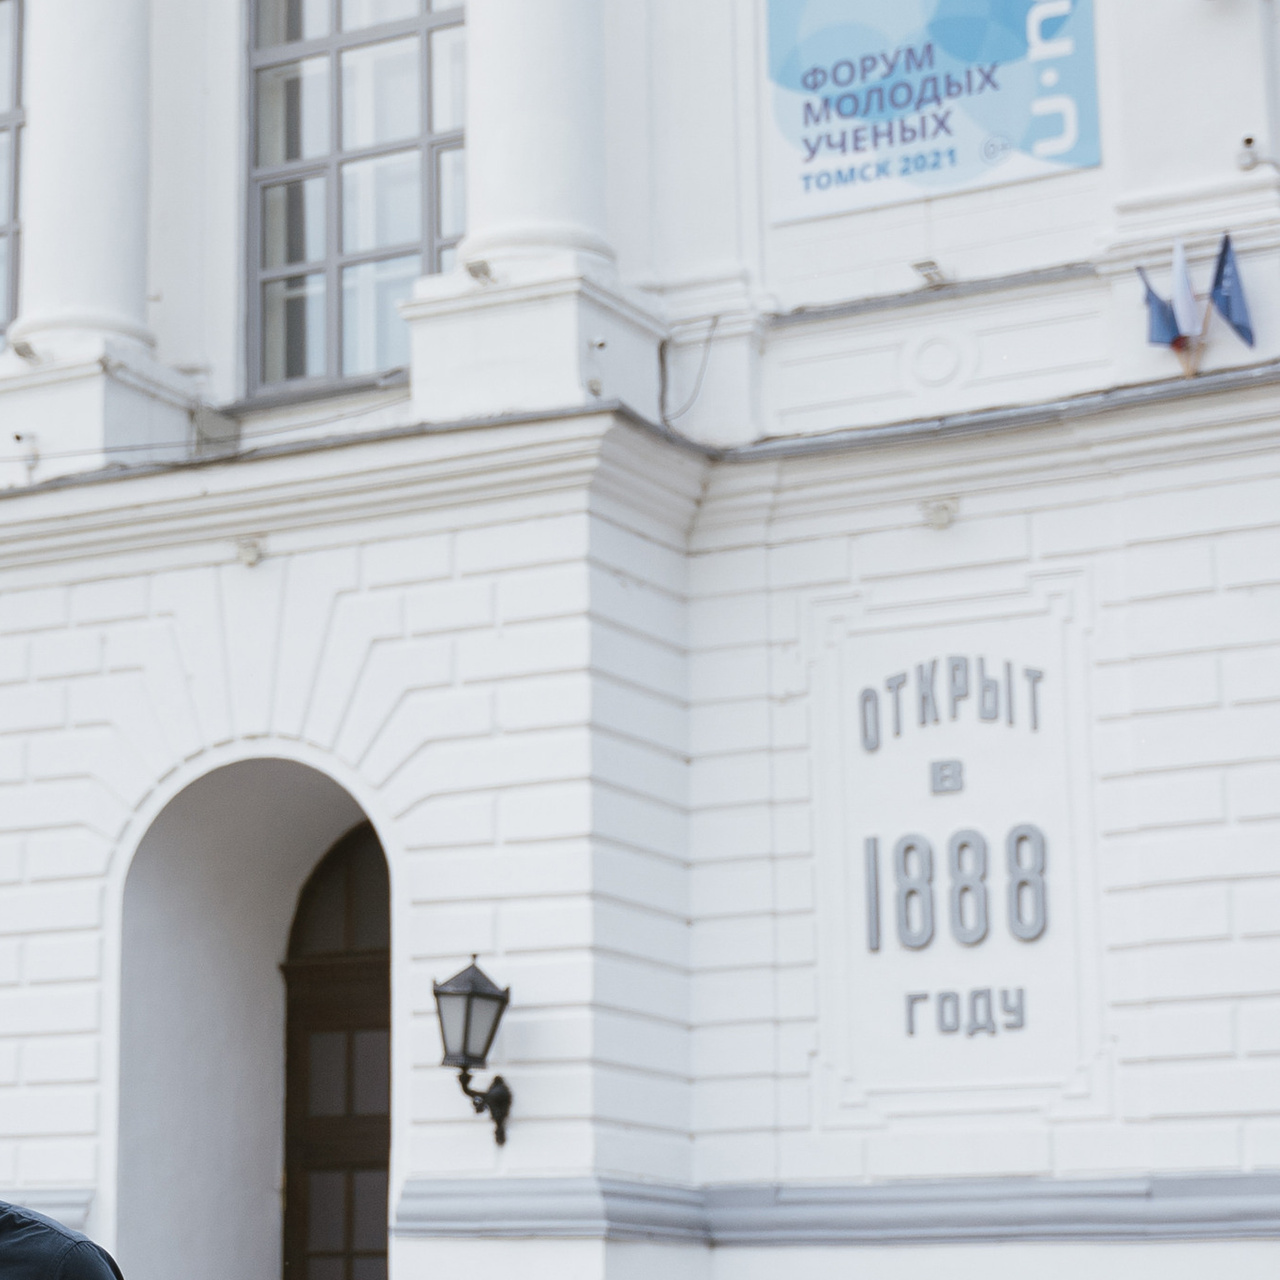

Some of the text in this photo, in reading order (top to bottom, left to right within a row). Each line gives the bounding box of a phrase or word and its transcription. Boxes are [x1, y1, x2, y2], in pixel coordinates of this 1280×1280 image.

[801, 43, 936, 92] ФОРУМ
[802, 63, 1001, 128] МОЛОДЫХ
[802, 111, 954, 163] УЧЕНЫХ
[802, 148, 958, 193] ТОМСК 2021
[859, 656, 1044, 752] ОТКРЫТ
[930, 760, 964, 795] В
[864, 824, 1048, 953] 1888
[905, 987, 1026, 1037] ГОДУ
